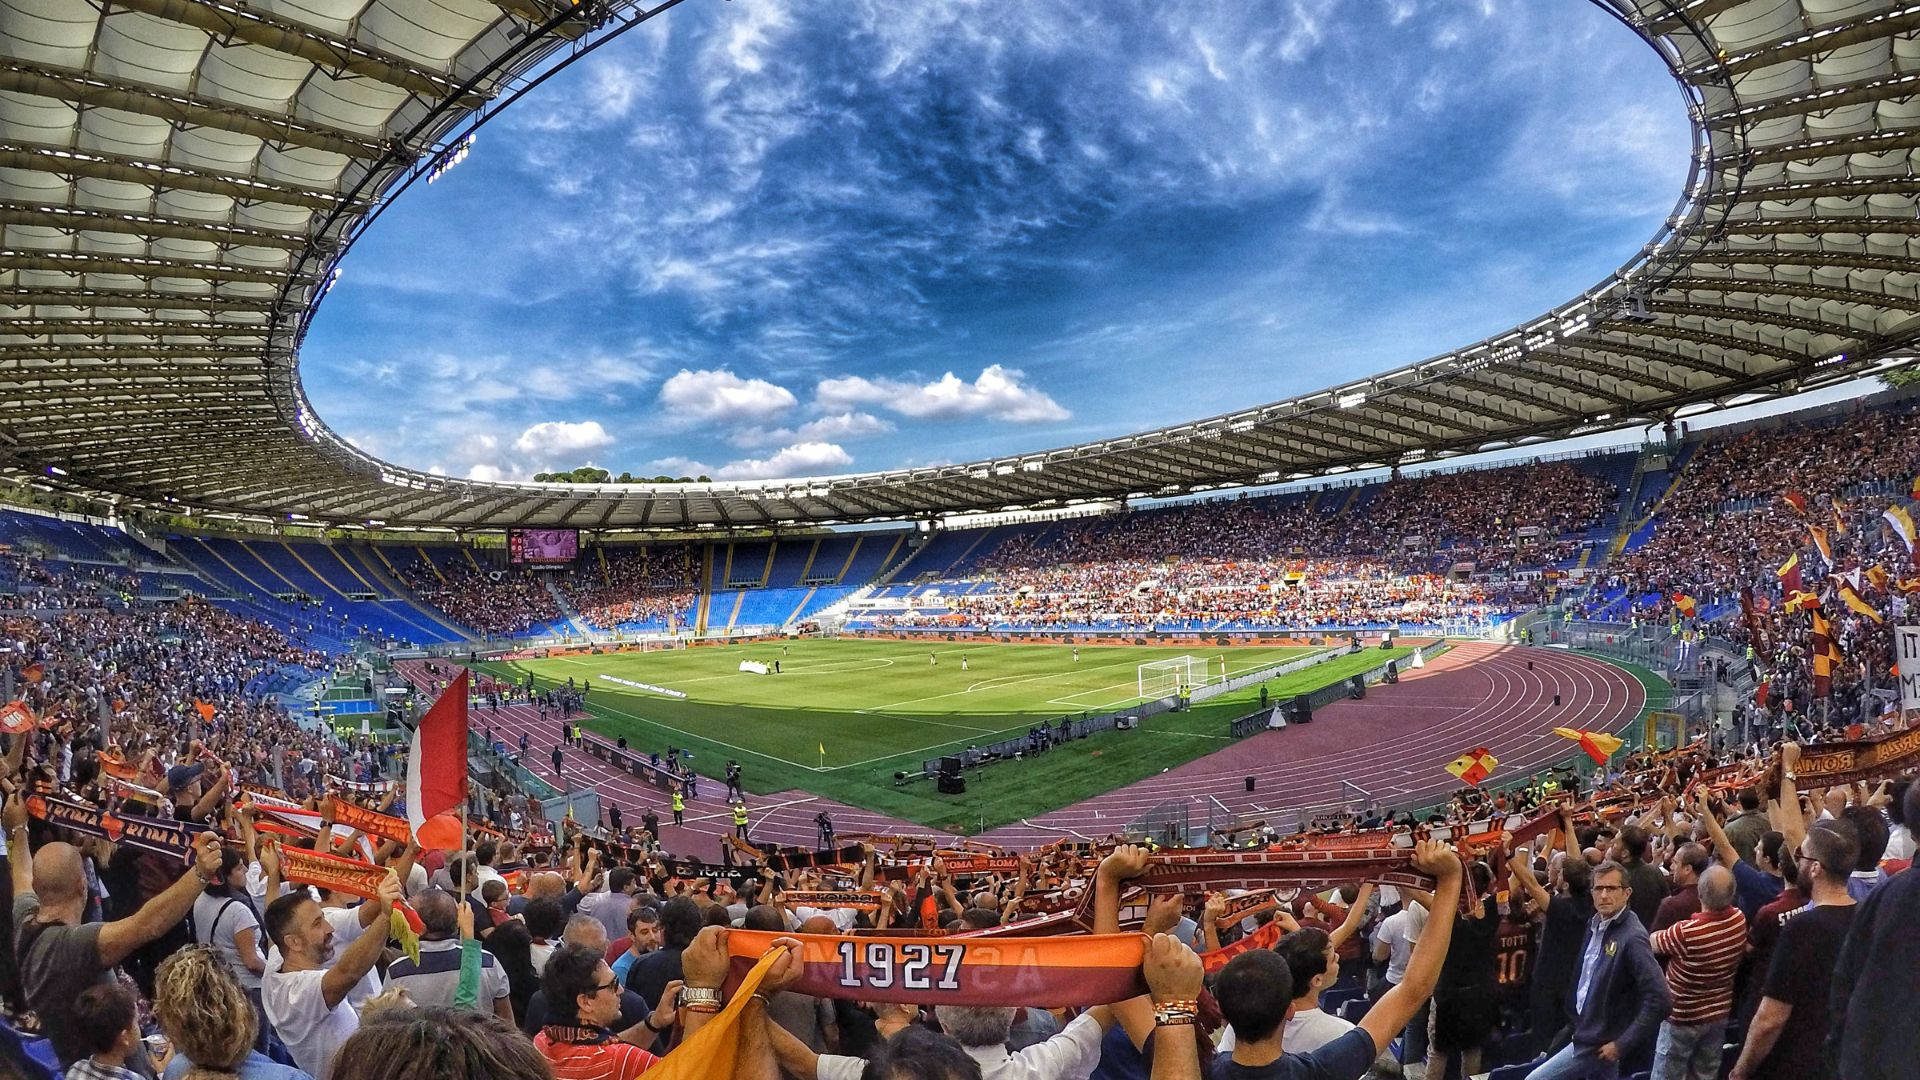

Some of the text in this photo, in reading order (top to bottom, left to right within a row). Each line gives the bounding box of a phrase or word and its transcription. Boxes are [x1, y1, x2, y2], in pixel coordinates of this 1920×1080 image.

[126, 823, 182, 849] ROMA
[989, 858, 1019, 868] ROMA
[839, 942, 966, 989] 1927
[1497, 949, 1527, 984] 10
